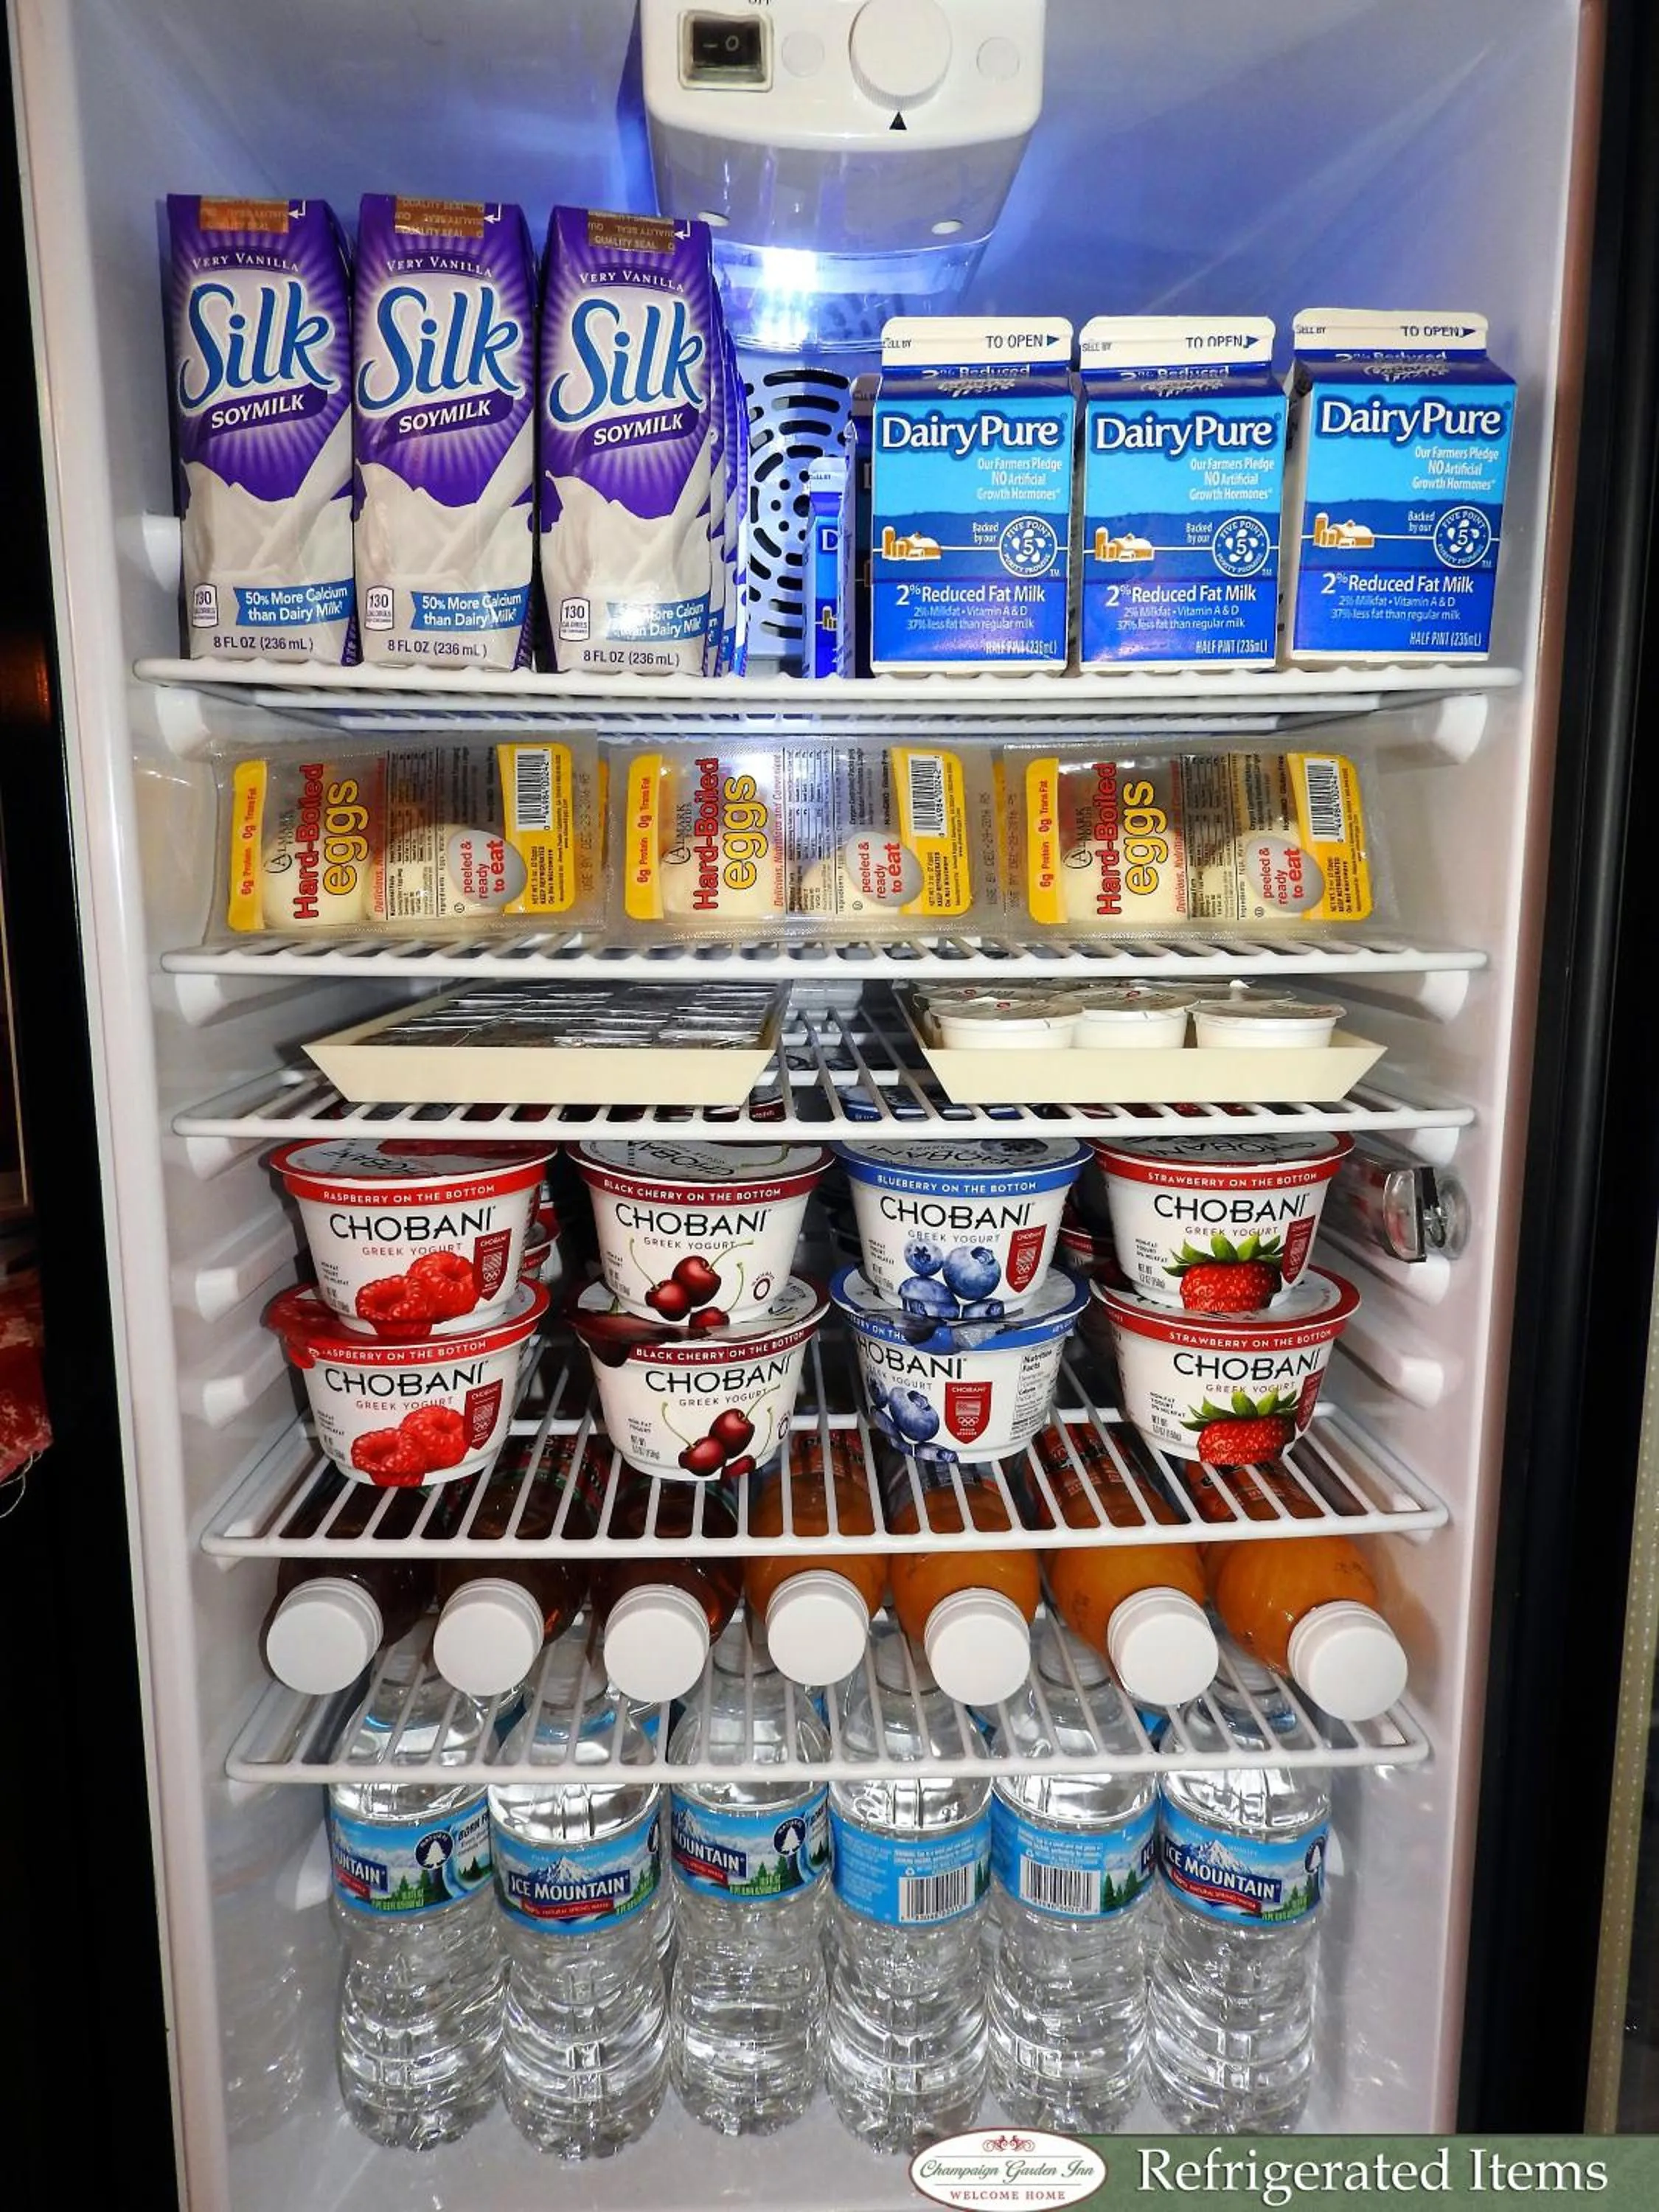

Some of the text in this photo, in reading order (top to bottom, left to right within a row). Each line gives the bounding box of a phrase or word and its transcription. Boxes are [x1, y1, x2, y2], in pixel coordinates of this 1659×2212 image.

[192, 253, 299, 272] VERY VANILLA
[386, 257, 492, 277] VERY VANILLA
[580, 271, 684, 292] VERY VANILLA
[986, 335, 1043, 348] TO OPEN
[1401, 327, 1458, 337] TO OPEN
[180, 282, 335, 409] Silk
[358, 287, 521, 410] Silk
[549, 299, 703, 422] Silk
[211, 393, 305, 428] SOYMILK
[398, 399, 490, 433] SOYMILK
[1321, 401, 1500, 442] DairyPure
[594, 413, 684, 446] SOYMILK
[883, 415, 1058, 454] DairyPure
[1097, 417, 1272, 455] DairyPure
[1433, 447, 1467, 459] Farmers
[1470, 447, 1499, 460] Pledge
[1428, 461, 1441, 473] NO
[1006, 521, 1051, 538] FIVE POINT
[1443, 511, 1486, 528] FIVE POINT
[1023, 540, 1034, 554] 5
[1458, 529, 1468, 545] 5
[897, 585, 1045, 605] 2% Reduced Fat Milk
[1106, 585, 1256, 606] 2% Reduced Fat Milk
[1321, 572, 1473, 594] 2% Reduced Fat Milk
[195, 591, 212, 605] 130
[246, 587, 347, 605] 50% More Calcium
[369, 594, 389, 608] 130
[422, 594, 521, 610] 50% More Calcium
[248, 607, 313, 621] than Dairy
[424, 613, 487, 628] than Dairy
[564, 605, 585, 619] 130
[214, 637, 221, 648] 8
[224, 637, 237, 648] FL
[240, 637, 256, 648] OZ
[260, 637, 285, 650] (236
[584, 650, 590, 661] 8
[594, 650, 606, 662] FL
[610, 651, 625, 663] OZ
[629, 651, 653, 665] (236
[293, 764, 324, 919] Hard-Boiled
[323, 779, 369, 895] eggs
[637, 790, 652, 883] 6g Protein 0g Trans
[693, 758, 719, 910] Hard-Boiled
[722, 775, 768, 889] eggs
[1092, 762, 1121, 915] Hard-Boiled
[1122, 780, 1169, 895] eggs
[1038, 818, 1053, 888] 6g 0g
[460, 841, 475, 893] peeled &
[487, 841, 505, 892] to eat
[858, 841, 872, 893] peeled &
[886, 842, 902, 893] to eat
[1259, 847, 1274, 899] peeled &
[1284, 848, 1304, 898] to eat
[478, 863, 490, 899] ready
[874, 863, 886, 899] ready
[1275, 869, 1287, 904] ready
[604, 1179, 633, 1194] BLACK
[637, 1189, 682, 1200] CHERRY
[710, 1193, 732, 1201] THE
[737, 1189, 781, 1200] BOTTOM
[877, 1175, 1036, 1193] BLUEBERRY ON THE BOTTOM
[1149, 1172, 1225, 1187] STRAWBERRY
[1252, 1178, 1273, 1186] THE
[1276, 1172, 1317, 1185] BOTTOM
[324, 1186, 495, 1203] RASPBERRY ON THE BOTTOM
[616, 1203, 765, 1237] CHOBANI
[880, 1196, 1030, 1230] CHOBANI
[1154, 1194, 1305, 1223] CHOBANI
[330, 1206, 492, 1241] CHOBANI
[1186, 1227, 1278, 1237] GREEK YOGURT
[644, 1237, 736, 1250] GREEK YOGURT
[908, 1230, 1001, 1243] GREEK YOGURT
[362, 1243, 463, 1256] GREEK YOGURT
[387, 1352, 405, 1360] ON
[410, 1350, 433, 1359] THE
[438, 1340, 486, 1356] BOTTOM
[636, 1331, 804, 1360] BLACK CHERRY ON THE BOTTOM
[1169, 1332, 1247, 1348] STRAWBERRY
[1274, 1338, 1293, 1346] THE
[1297, 1329, 1331, 1343] BOTTOM
[858, 1335, 961, 1379] HOBANI
[1173, 1348, 1320, 1381] CHOBANI
[325, 1363, 483, 1397] CHOBANI
[646, 1355, 790, 1393] CHOBANI
[892, 1377, 932, 1390] YOGURT
[679, 1389, 768, 1406] GREEK YOGURT
[1206, 1381, 1295, 1393] GREEK YOGURT
[356, 1397, 453, 1411] GREEK YOGURT
[338, 1851, 379, 1884] UNTAIN
[1166, 1842, 1182, 1868] ICE
[1185, 1856, 1274, 1899] MOUNTAIN
[512, 1875, 625, 1900] ICE MOUNTAIN
